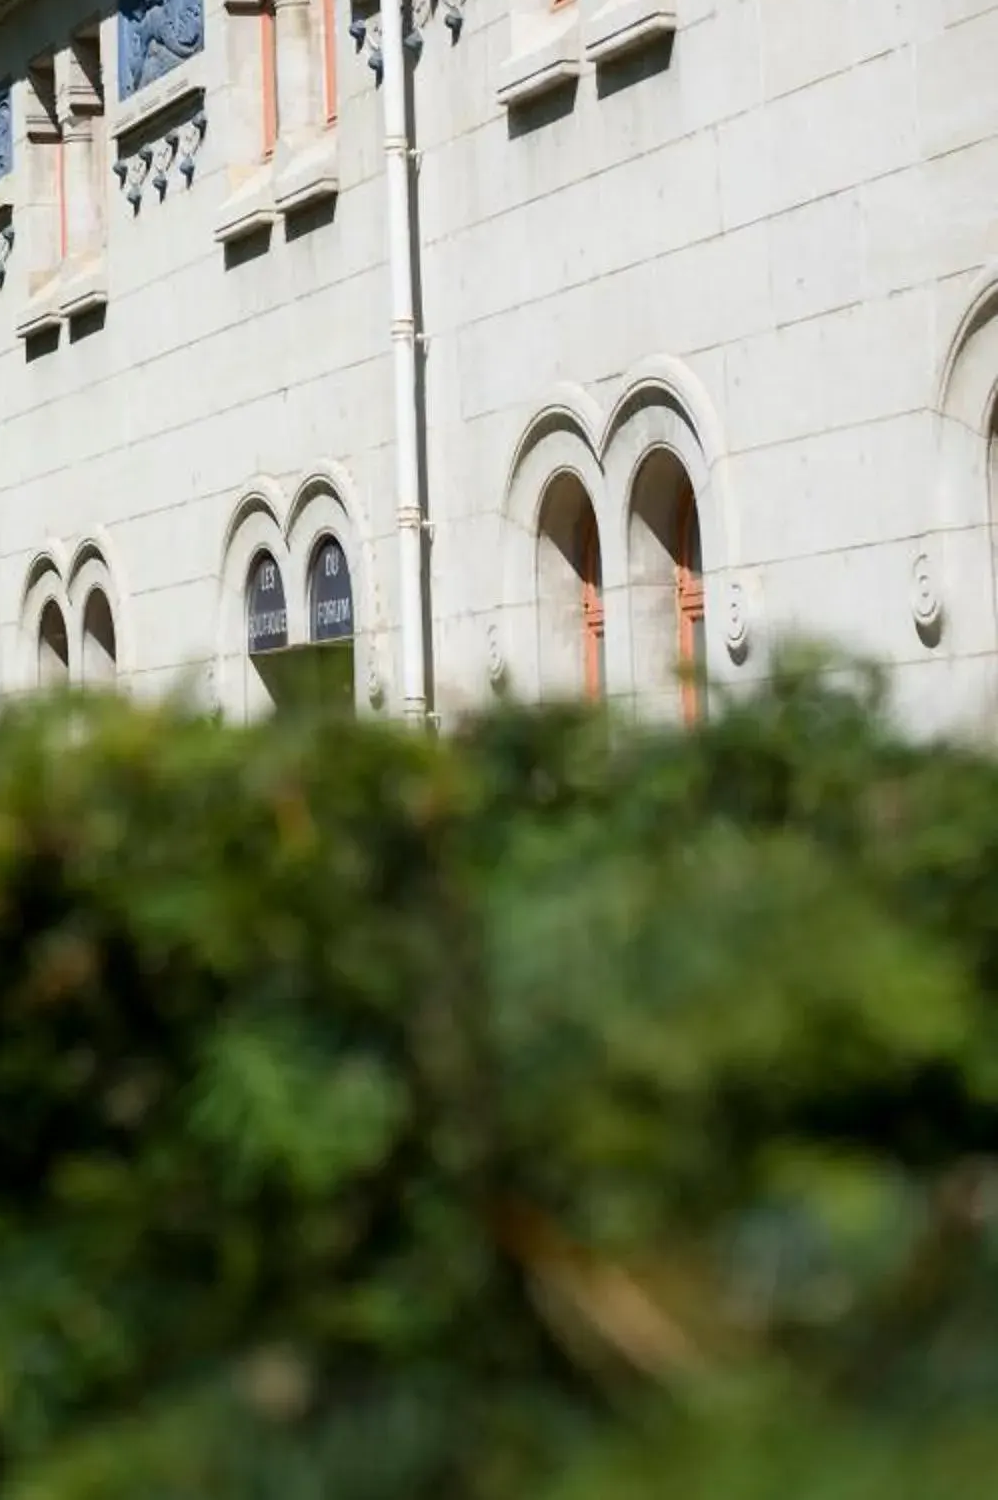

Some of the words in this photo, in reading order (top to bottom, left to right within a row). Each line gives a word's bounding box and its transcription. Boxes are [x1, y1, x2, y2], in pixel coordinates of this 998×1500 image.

[325, 550, 339, 577] DU
[261, 565, 275, 590] LES
[317, 597, 350, 625] FORUM
